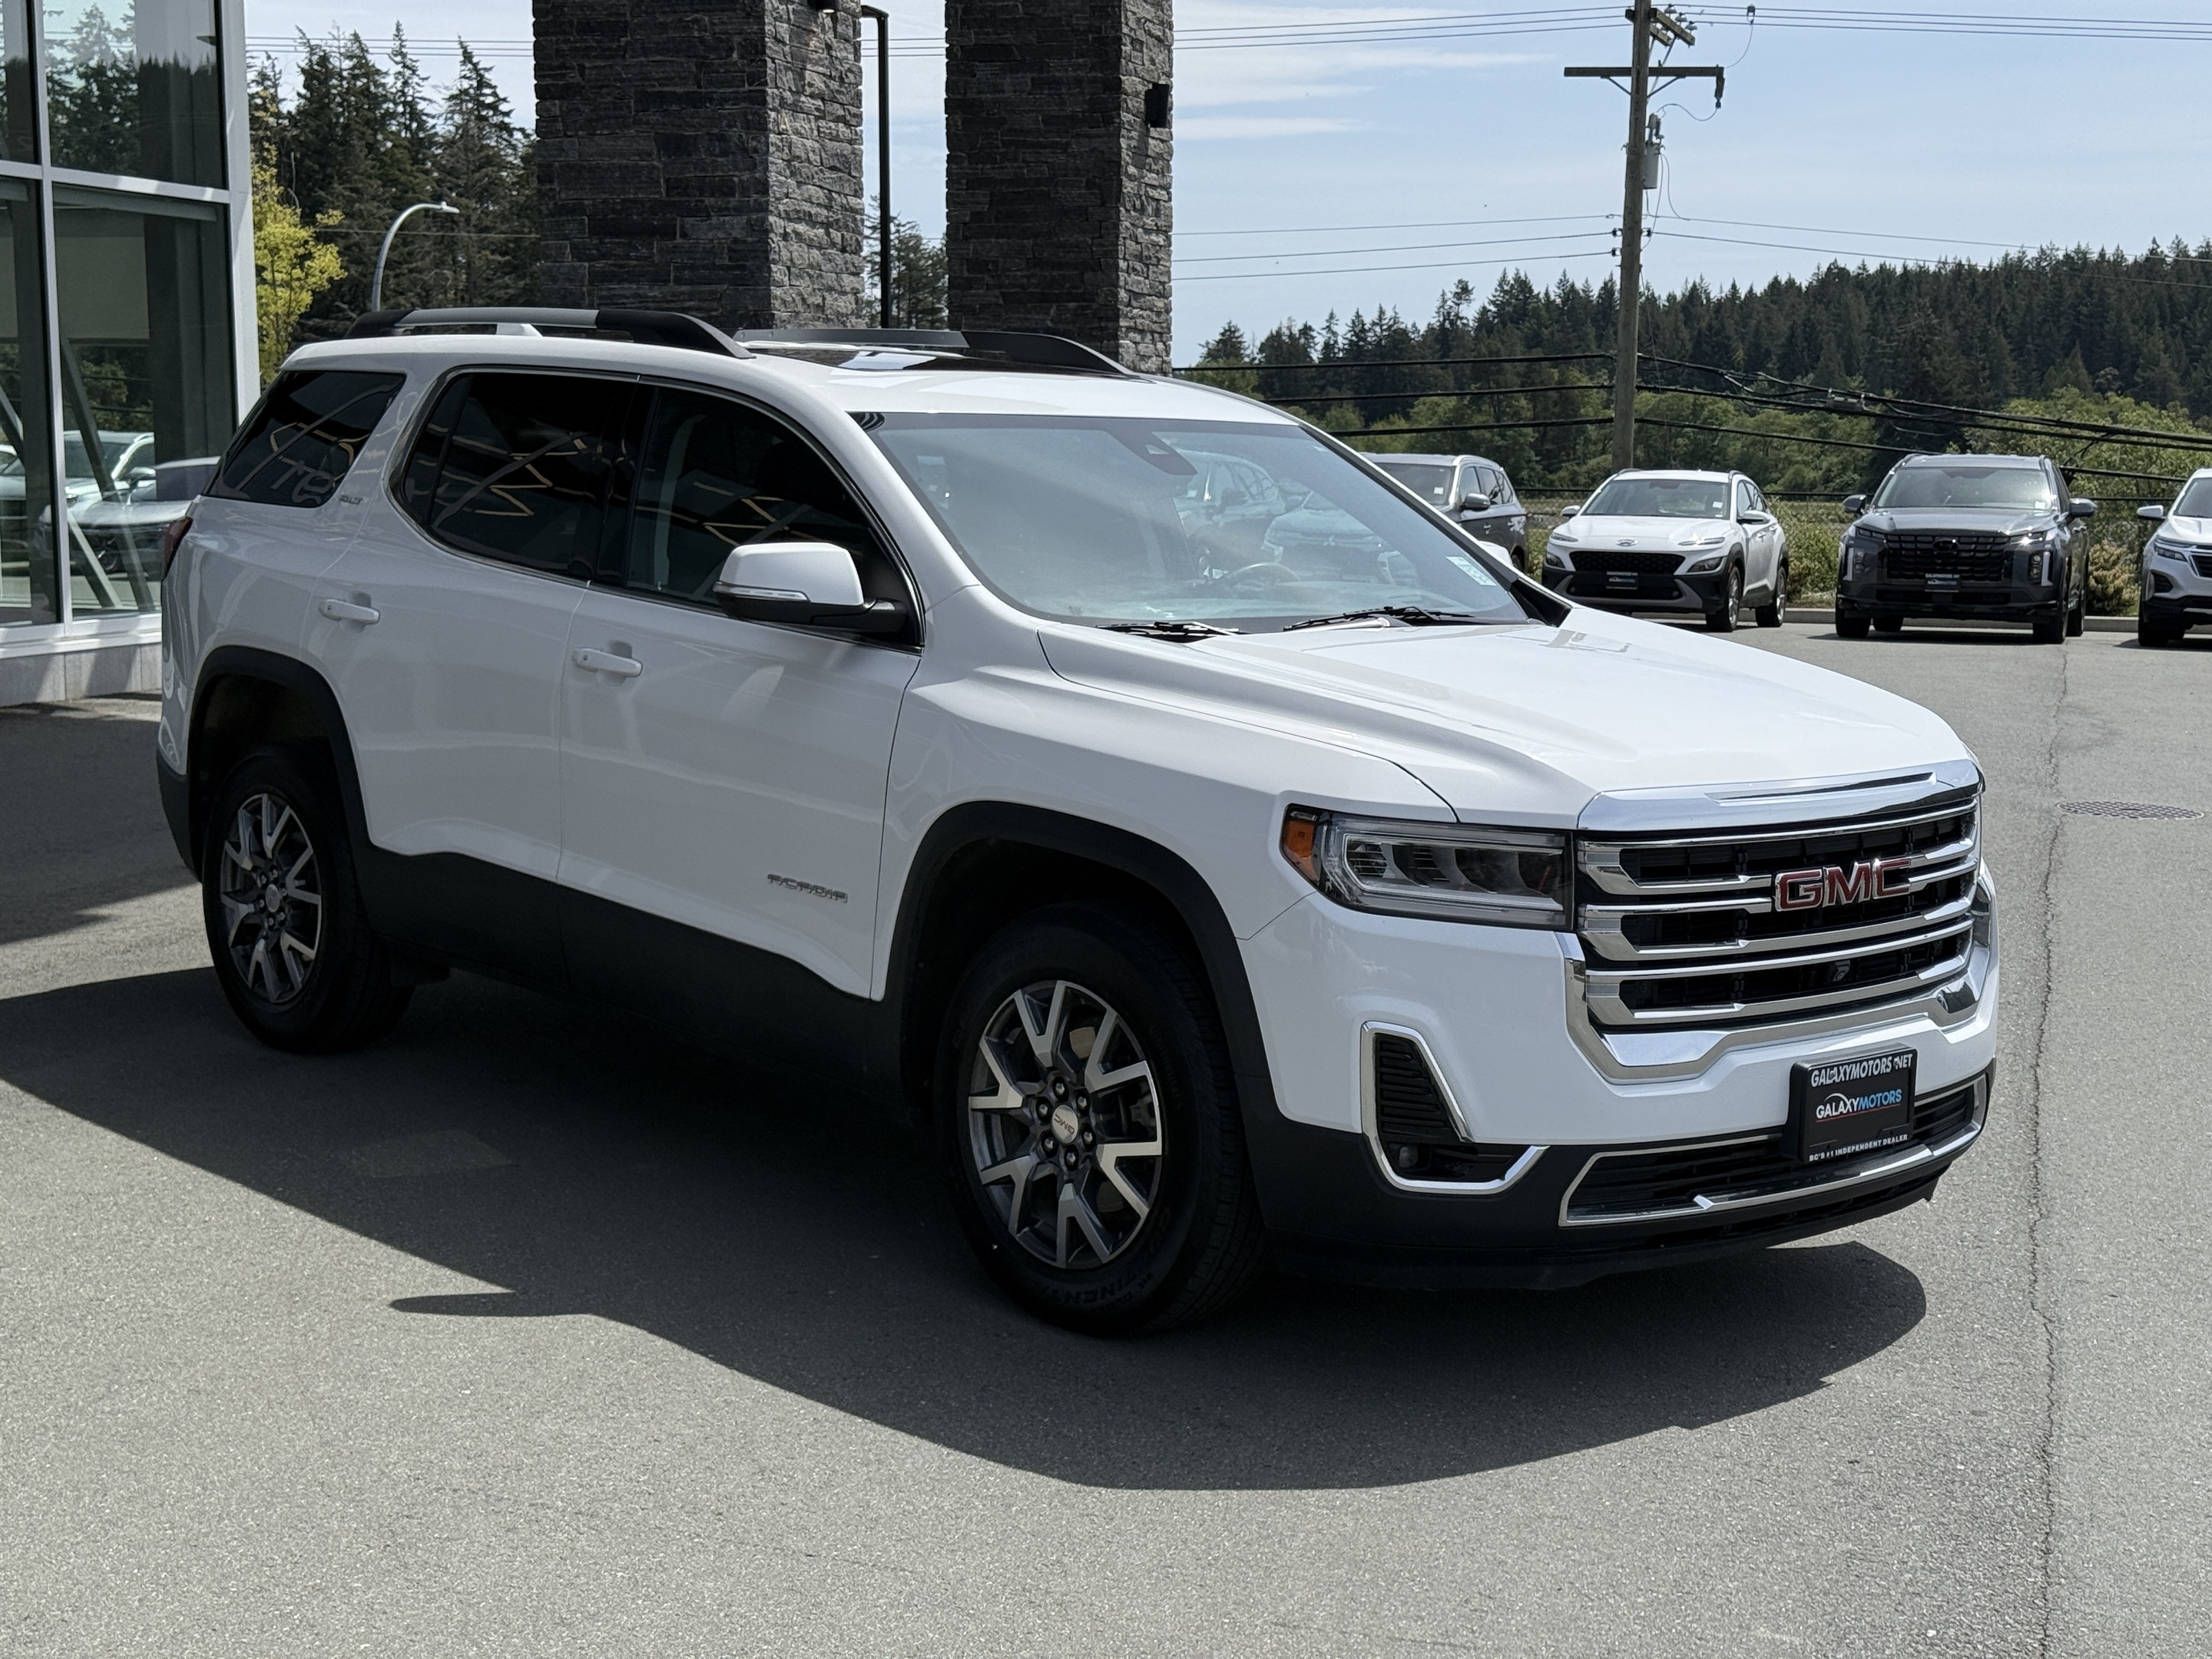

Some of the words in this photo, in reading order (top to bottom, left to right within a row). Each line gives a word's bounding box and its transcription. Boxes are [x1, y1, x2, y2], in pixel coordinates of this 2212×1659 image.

[1775, 858, 1911, 912] GMC
[1053, 1113, 1075, 1134] GMC
[1835, 1139, 1883, 1156] INDEPENDENT
[1883, 1134, 1908, 1145] DEALER
